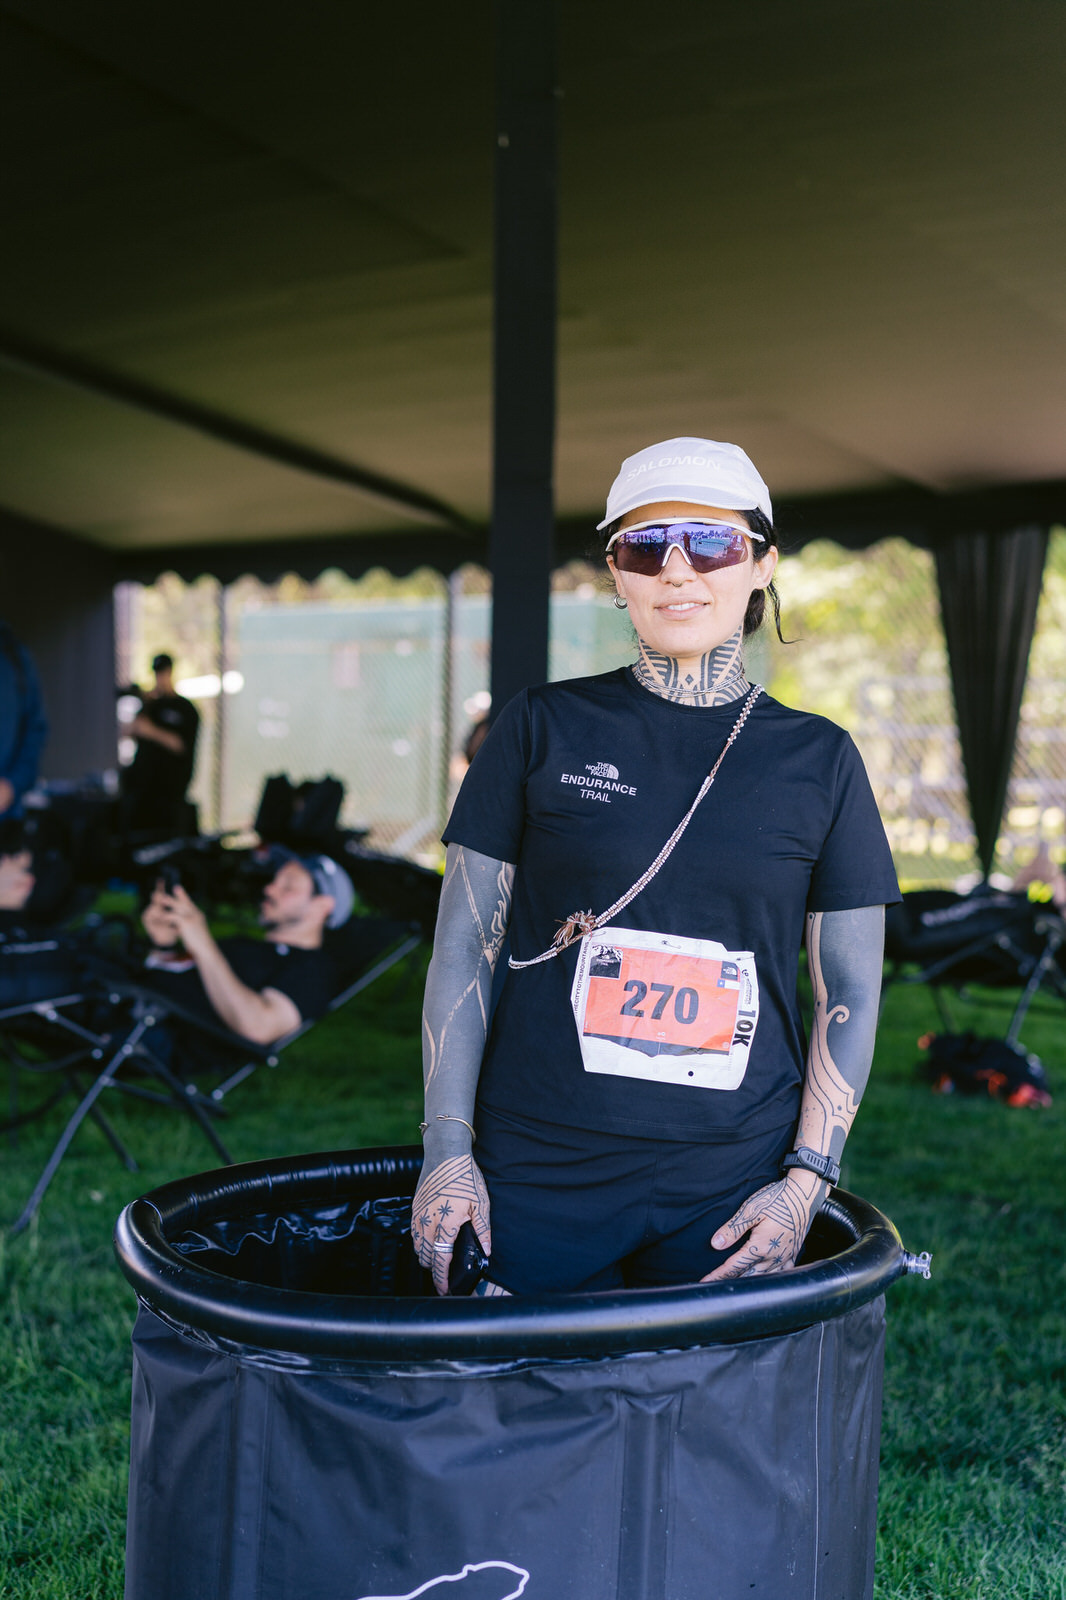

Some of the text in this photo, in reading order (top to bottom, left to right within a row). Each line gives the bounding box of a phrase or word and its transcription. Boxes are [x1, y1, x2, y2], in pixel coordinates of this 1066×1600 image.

[626, 455, 721, 481] SALOMON
[585, 764, 609, 772] NORTH
[560, 773, 637, 796] ENDURANCE
[579, 788, 611, 803] TRAIL
[619, 979, 699, 1025] 270
[732, 1009, 756, 1048] 10K
